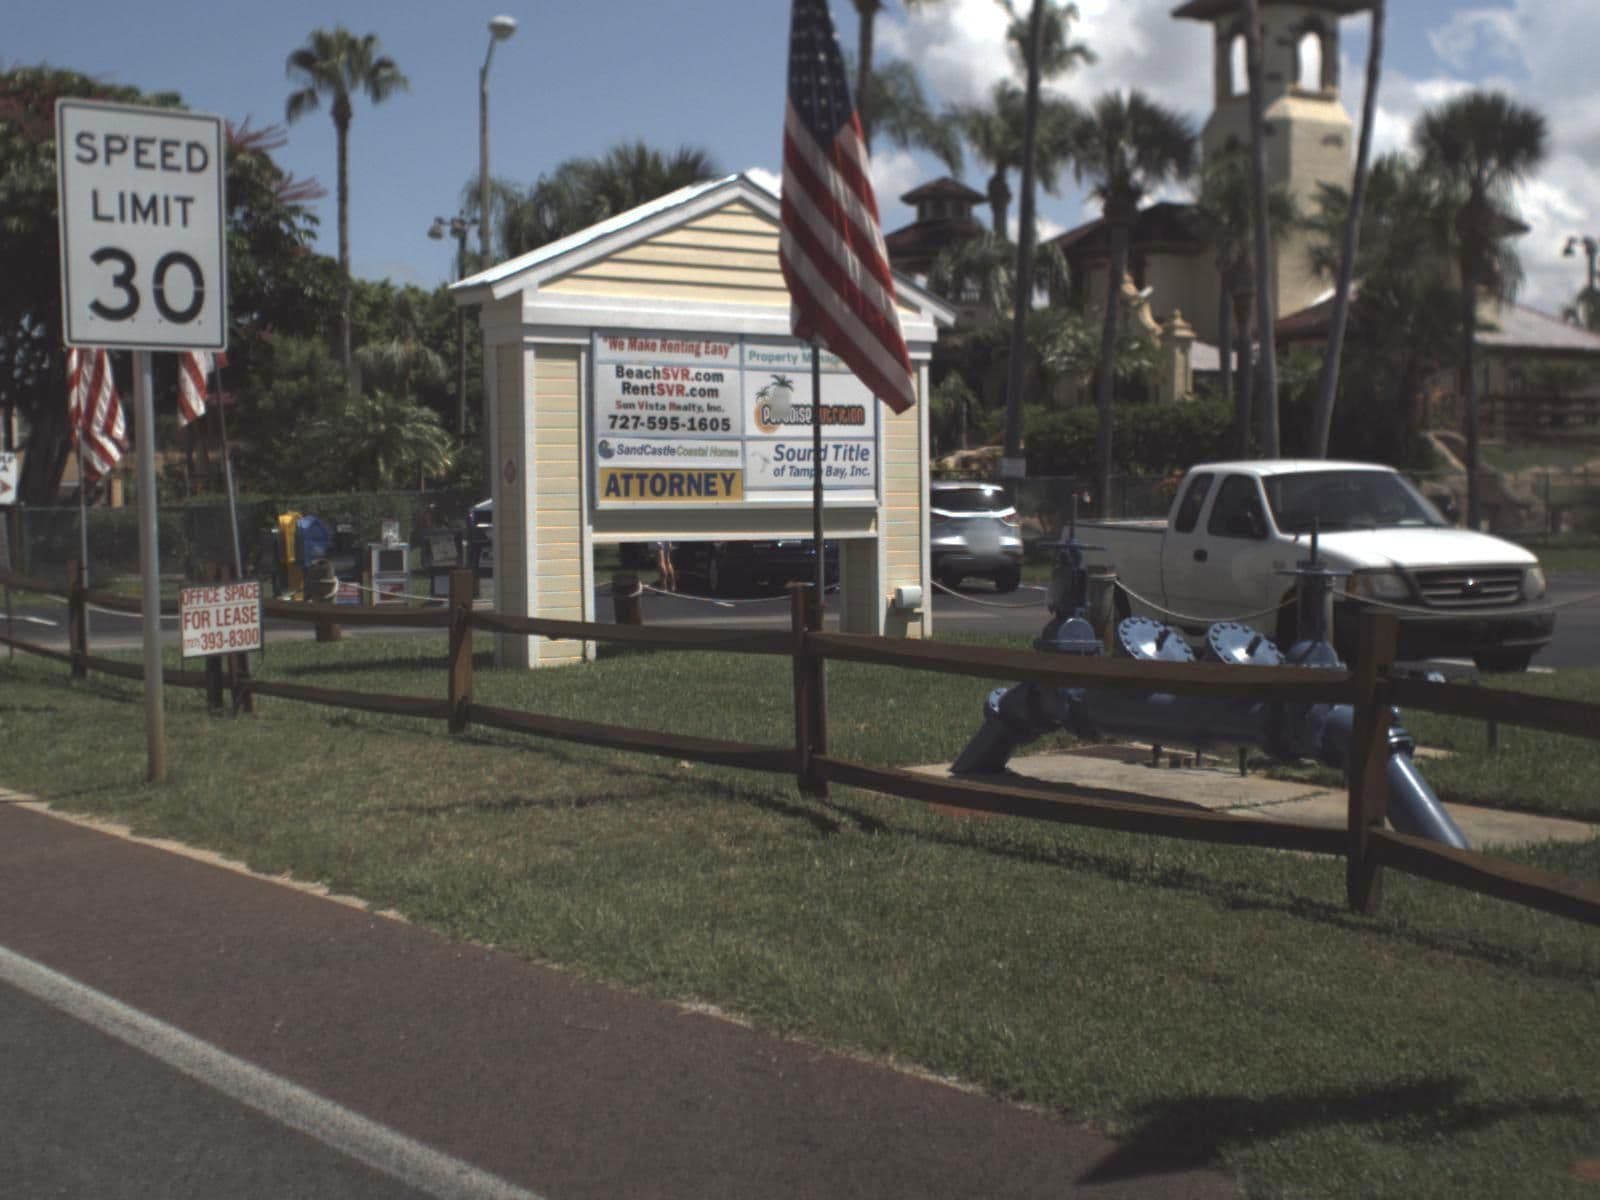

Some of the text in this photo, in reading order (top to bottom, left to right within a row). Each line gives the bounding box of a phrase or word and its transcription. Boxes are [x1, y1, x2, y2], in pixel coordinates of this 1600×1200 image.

[74, 131, 209, 174] SPEED
[91, 188, 195, 228] LIMIT
[88, 245, 206, 325] 30
[627, 337, 657, 353] Make
[660, 339, 702, 357] Renting
[748, 350, 797, 364] Property
[615, 365, 724, 383] BeachSVR.com
[621, 381, 719, 398] RentSVR.com
[615, 400, 636, 410] Sun
[638, 400, 666, 411] Vista
[707, 403, 725, 413] Inc.
[608, 415, 731, 431] 727-595-1605
[616, 444, 676, 456] SandCastle
[831, 444, 870, 461] Title
[773, 465, 786, 477] of
[825, 466, 847, 479] Bay,
[849, 465, 870, 477] Inc.
[604, 472, 736, 497] ATTORNEY
[183, 584, 258, 605] OFFICE SPACE
[184, 606, 258, 630] FOR LEASE
[201, 628, 259, 650] 393-8300
